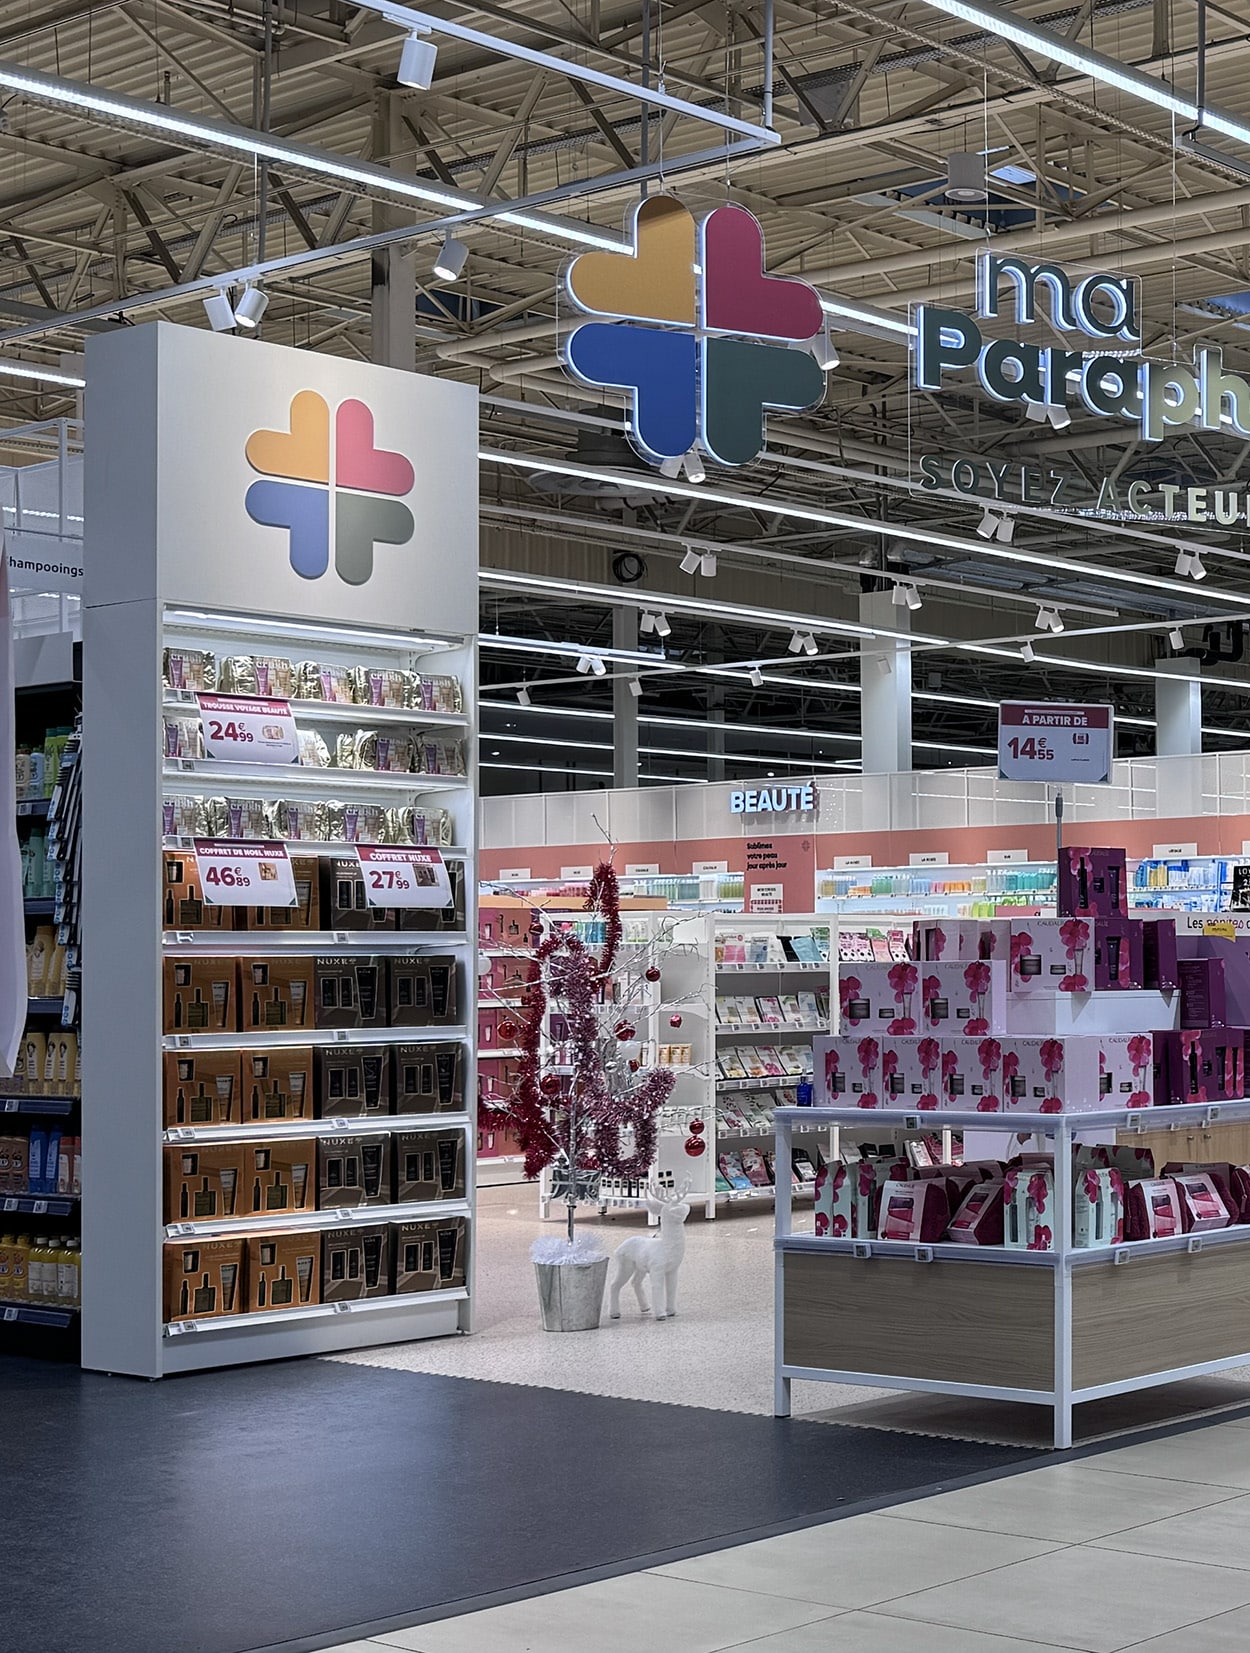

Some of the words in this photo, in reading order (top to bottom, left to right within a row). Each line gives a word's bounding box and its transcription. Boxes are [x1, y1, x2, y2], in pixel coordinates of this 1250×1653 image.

[978, 252, 1141, 342] ma
[919, 454, 1071, 505] SOYEZ
[7, 556, 84, 577] hampooings
[1022, 715, 1030, 724] A
[1032, 715, 1071, 726] PARTIR
[1073, 716, 1088, 726] DE
[730, 781, 814, 813] BEAUTÉ
[200, 847, 231, 855] COFFRET
[369, 852, 407, 861] COFFRET
[408, 854, 432, 863] NUXE
[1187, 916, 1204, 929] Les
